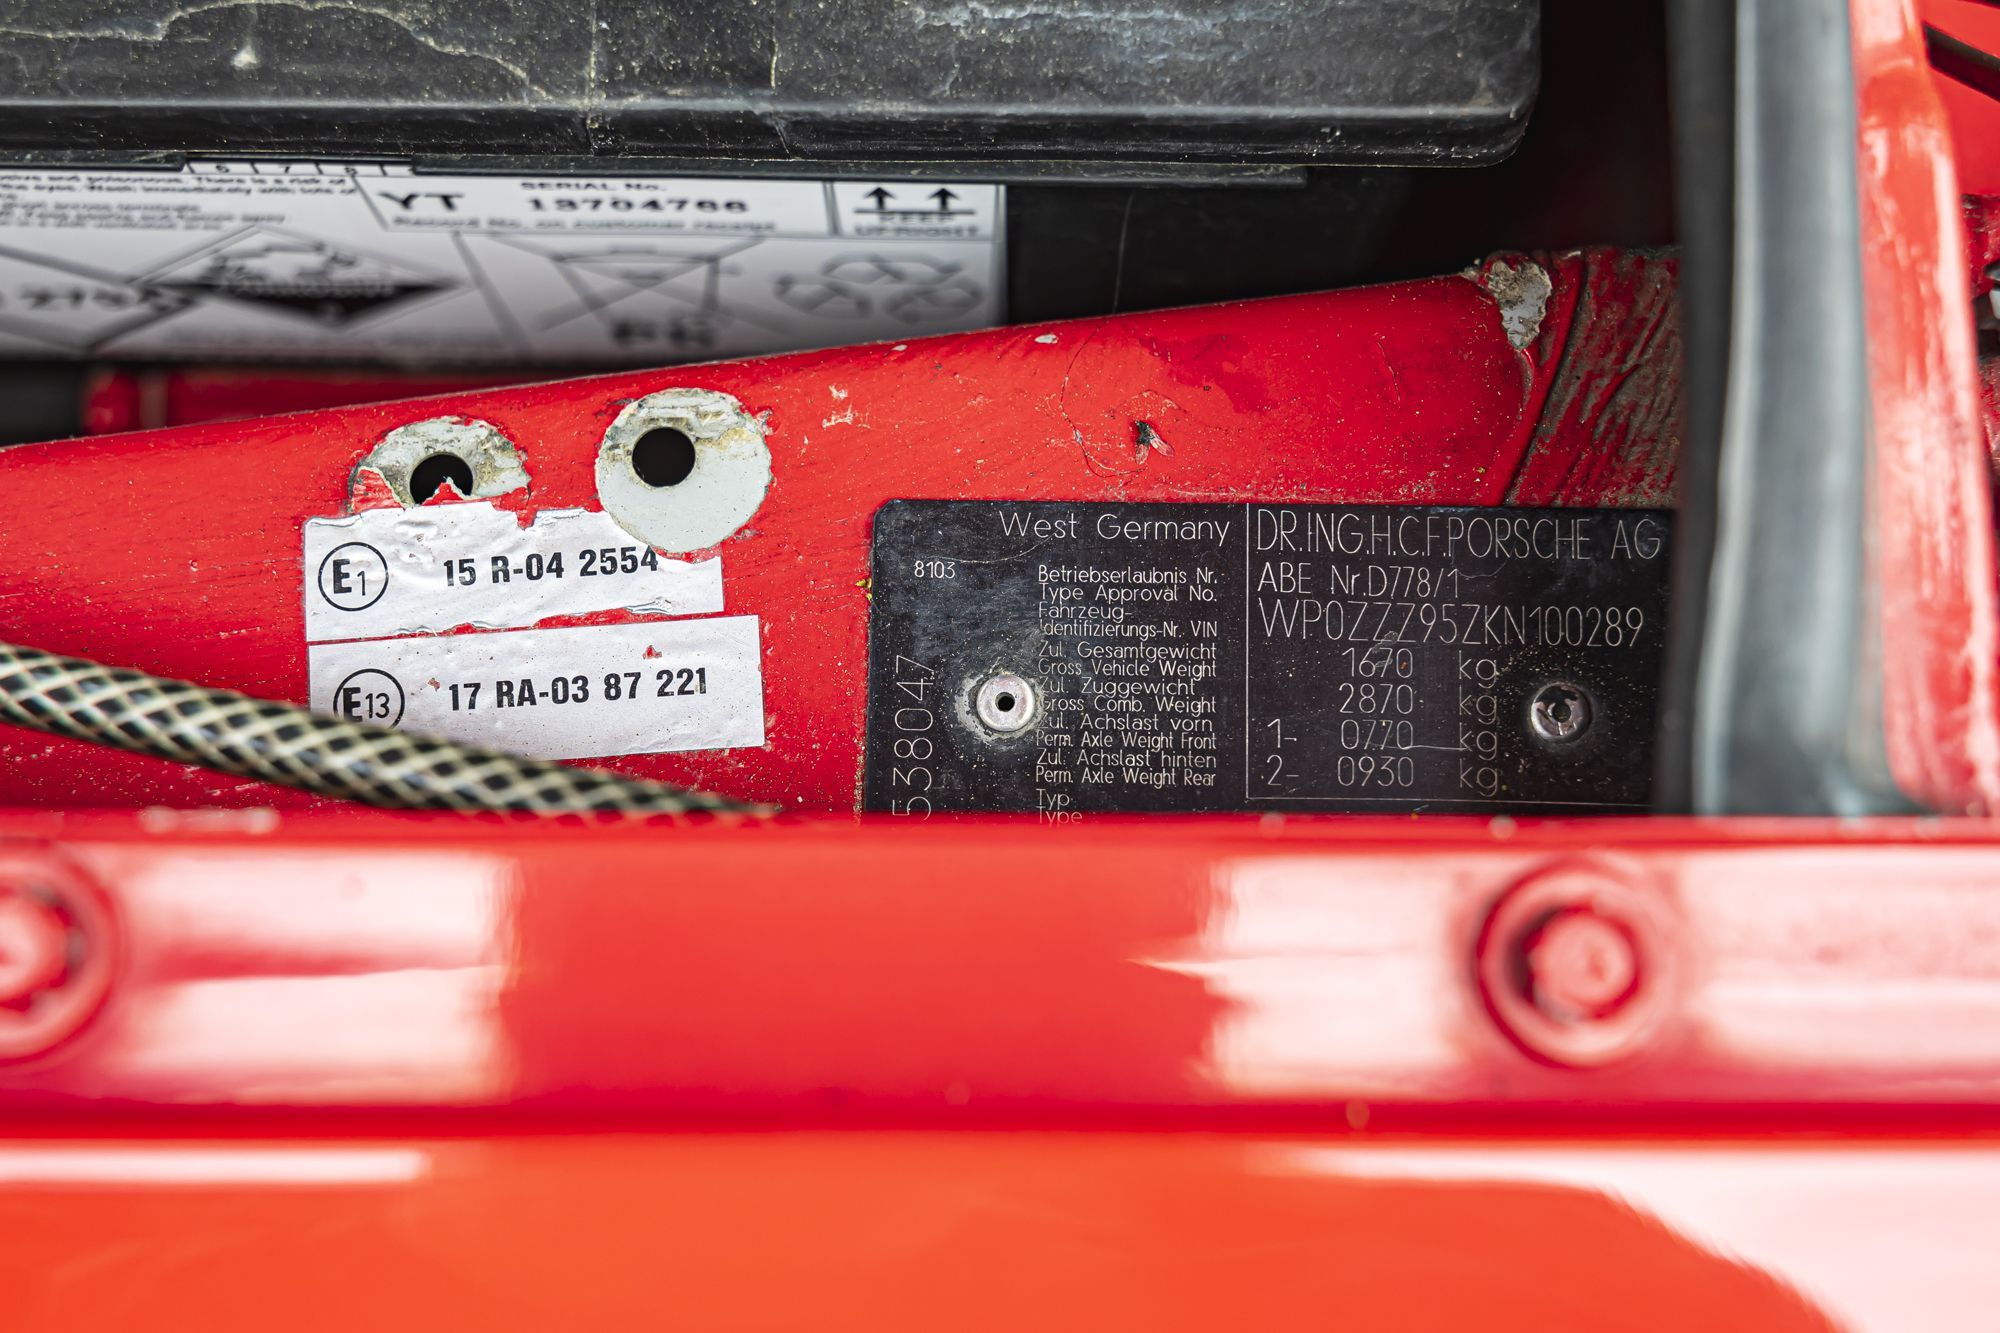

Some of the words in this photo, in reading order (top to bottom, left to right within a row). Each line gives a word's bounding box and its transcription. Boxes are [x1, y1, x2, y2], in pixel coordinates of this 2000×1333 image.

[520, 181, 618, 192] SERIAL
[377, 192, 464, 212] YT
[1000, 511, 1077, 540] West
[1096, 513, 1230, 547] Germany
[1257, 509, 1591, 560] DR.ING.H.C.F.PORSCHE
[1611, 519, 1661, 560] AG
[443, 557, 477, 587] 15
[491, 551, 564, 583] R-04
[578, 545, 659, 577] 2554
[914, 560, 956, 579] 8103
[1038, 565, 1187, 584] Betriebserlaubnis
[1196, 568, 1217, 584] Nr.
[1257, 562, 1311, 594] ABE
[1039, 583, 1084, 604] Type
[1095, 584, 1178, 604] Approval
[1189, 585, 1217, 602] No.
[1038, 602, 1132, 624] Fahrzeug-
[1190, 621, 1217, 638] VIN
[1038, 640, 1067, 658] Zul.
[1077, 640, 1217, 663] Gesamtgewicht
[1038, 658, 1082, 677] Gross
[1092, 659, 1150, 677] Vehicle
[1159, 660, 1217, 681] Weight
[1342, 647, 1414, 679] 1670
[1458, 650, 1499, 689] kg
[447, 682, 481, 712] 17
[496, 675, 590, 708] RA-03
[603, 671, 641, 701] 87
[655, 667, 707, 698] 221
[1081, 677, 1196, 697] Zuggewicht
[1039, 696, 1084, 712] Gross
[1095, 696, 1146, 713] Comb.
[1156, 697, 1217, 717] Weight
[1338, 683, 1414, 715] 2870
[1458, 685, 1499, 723] kg
[1080, 713, 1159, 731] Achslast
[1170, 719, 1213, 732] vorn
[1036, 731, 1074, 748] Perm.
[1082, 731, 1114, 748] Axle
[1122, 733, 1174, 753] Weight
[1180, 733, 1217, 750] Front
[1340, 719, 1414, 751] 0770
[1458, 721, 1499, 761] kg
[1077, 749, 1151, 767] Achslast
[1161, 751, 1217, 769] hinten
[1036, 768, 1074, 783] Perm.
[1082, 768, 1114, 784] Axle
[1123, 769, 1177, 788] Weight
[1183, 770, 1216, 787] Rear
[1337, 755, 1414, 788] 0930
[1458, 758, 1499, 797] kg
[1036, 788, 1071, 809] Typ
[1036, 809, 1083, 826] Type
